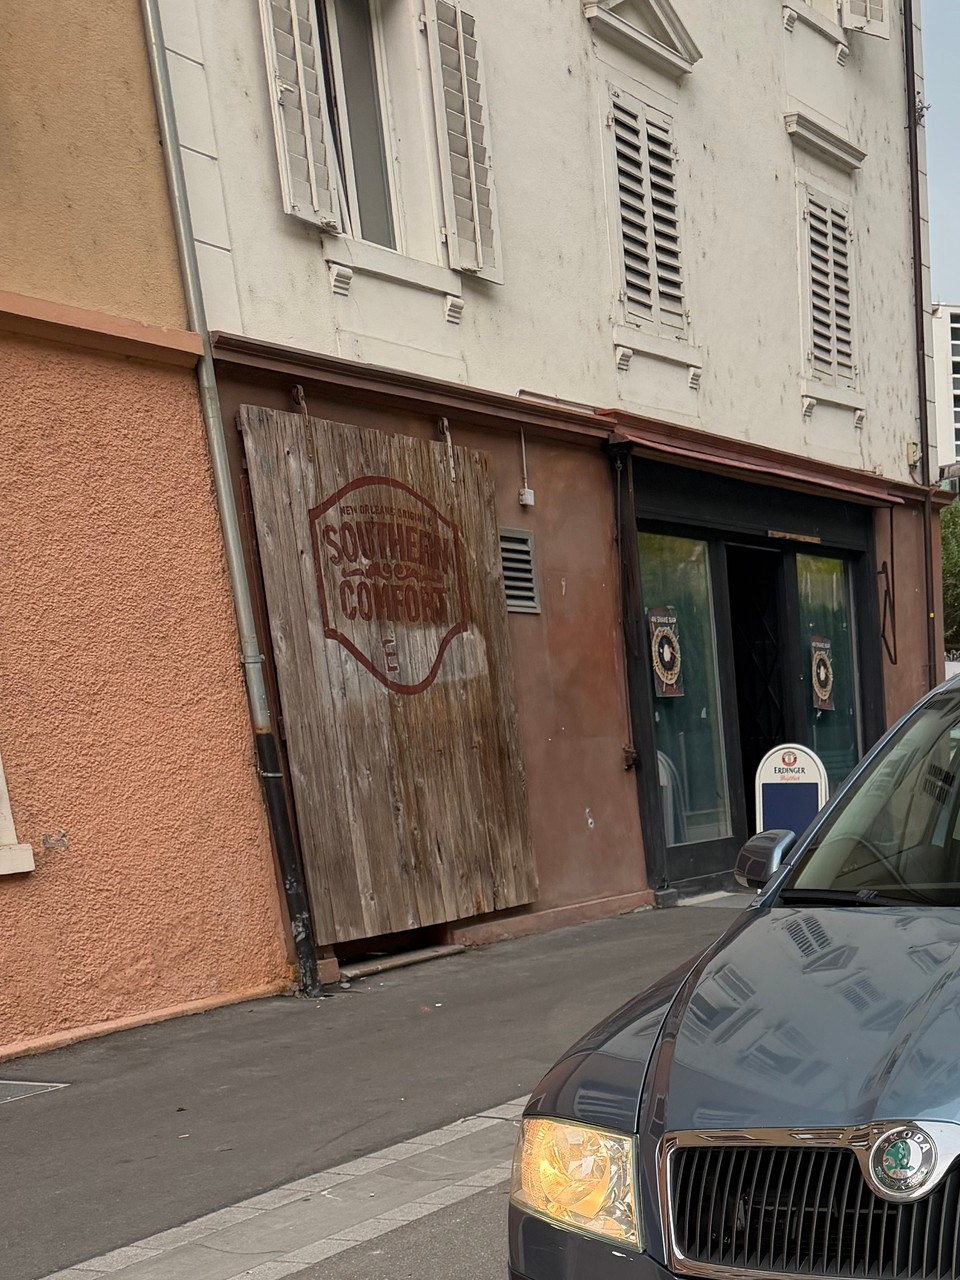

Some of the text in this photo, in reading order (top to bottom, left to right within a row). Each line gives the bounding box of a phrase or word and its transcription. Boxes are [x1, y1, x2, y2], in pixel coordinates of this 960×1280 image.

[340, 505, 357, 517] NEW
[323, 521, 449, 574] SOUTHERN
[340, 579, 448, 623] COMFORT
[773, 766, 806, 775] ERDINGER
